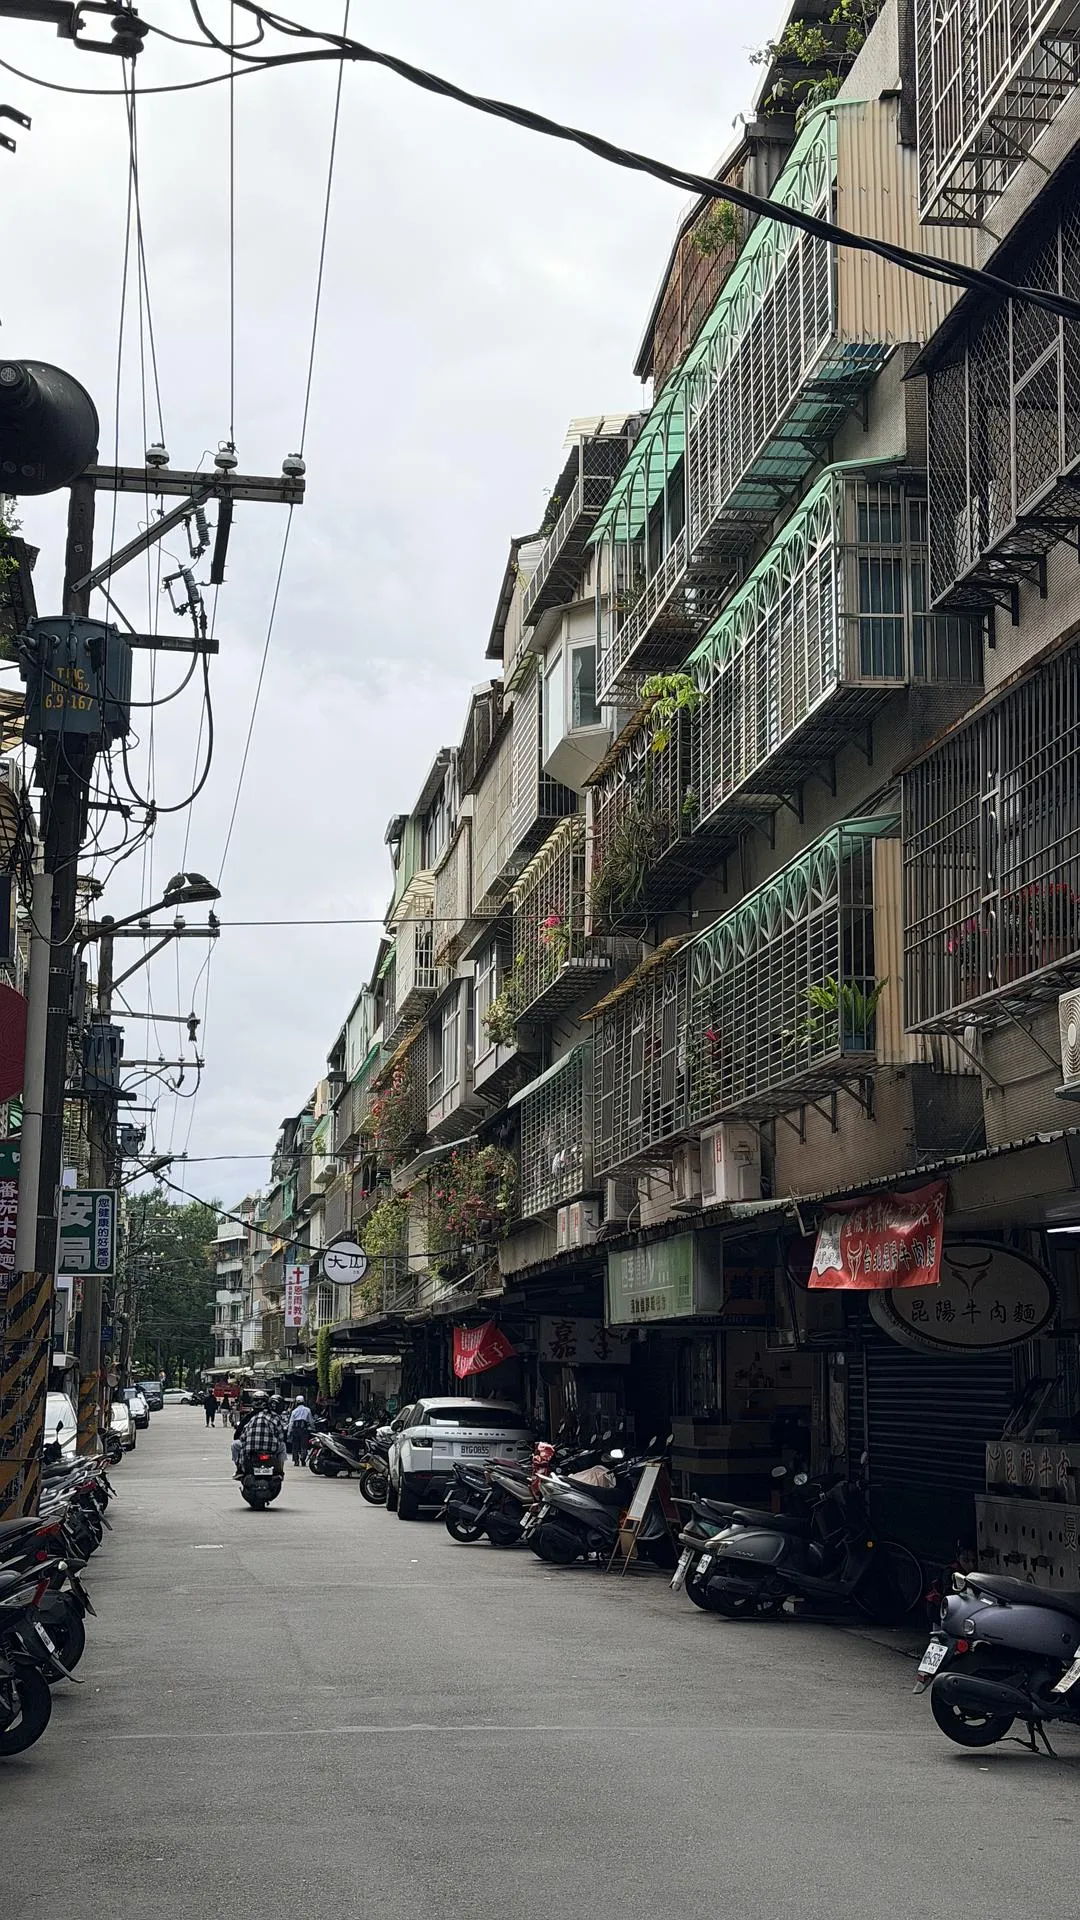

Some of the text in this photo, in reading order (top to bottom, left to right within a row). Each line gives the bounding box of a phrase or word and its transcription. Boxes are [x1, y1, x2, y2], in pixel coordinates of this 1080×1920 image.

[97, 1198, 110, 1267] 您健康的好鄰居
[911, 1299, 1037, 1325] 昆陽牛肉麵
